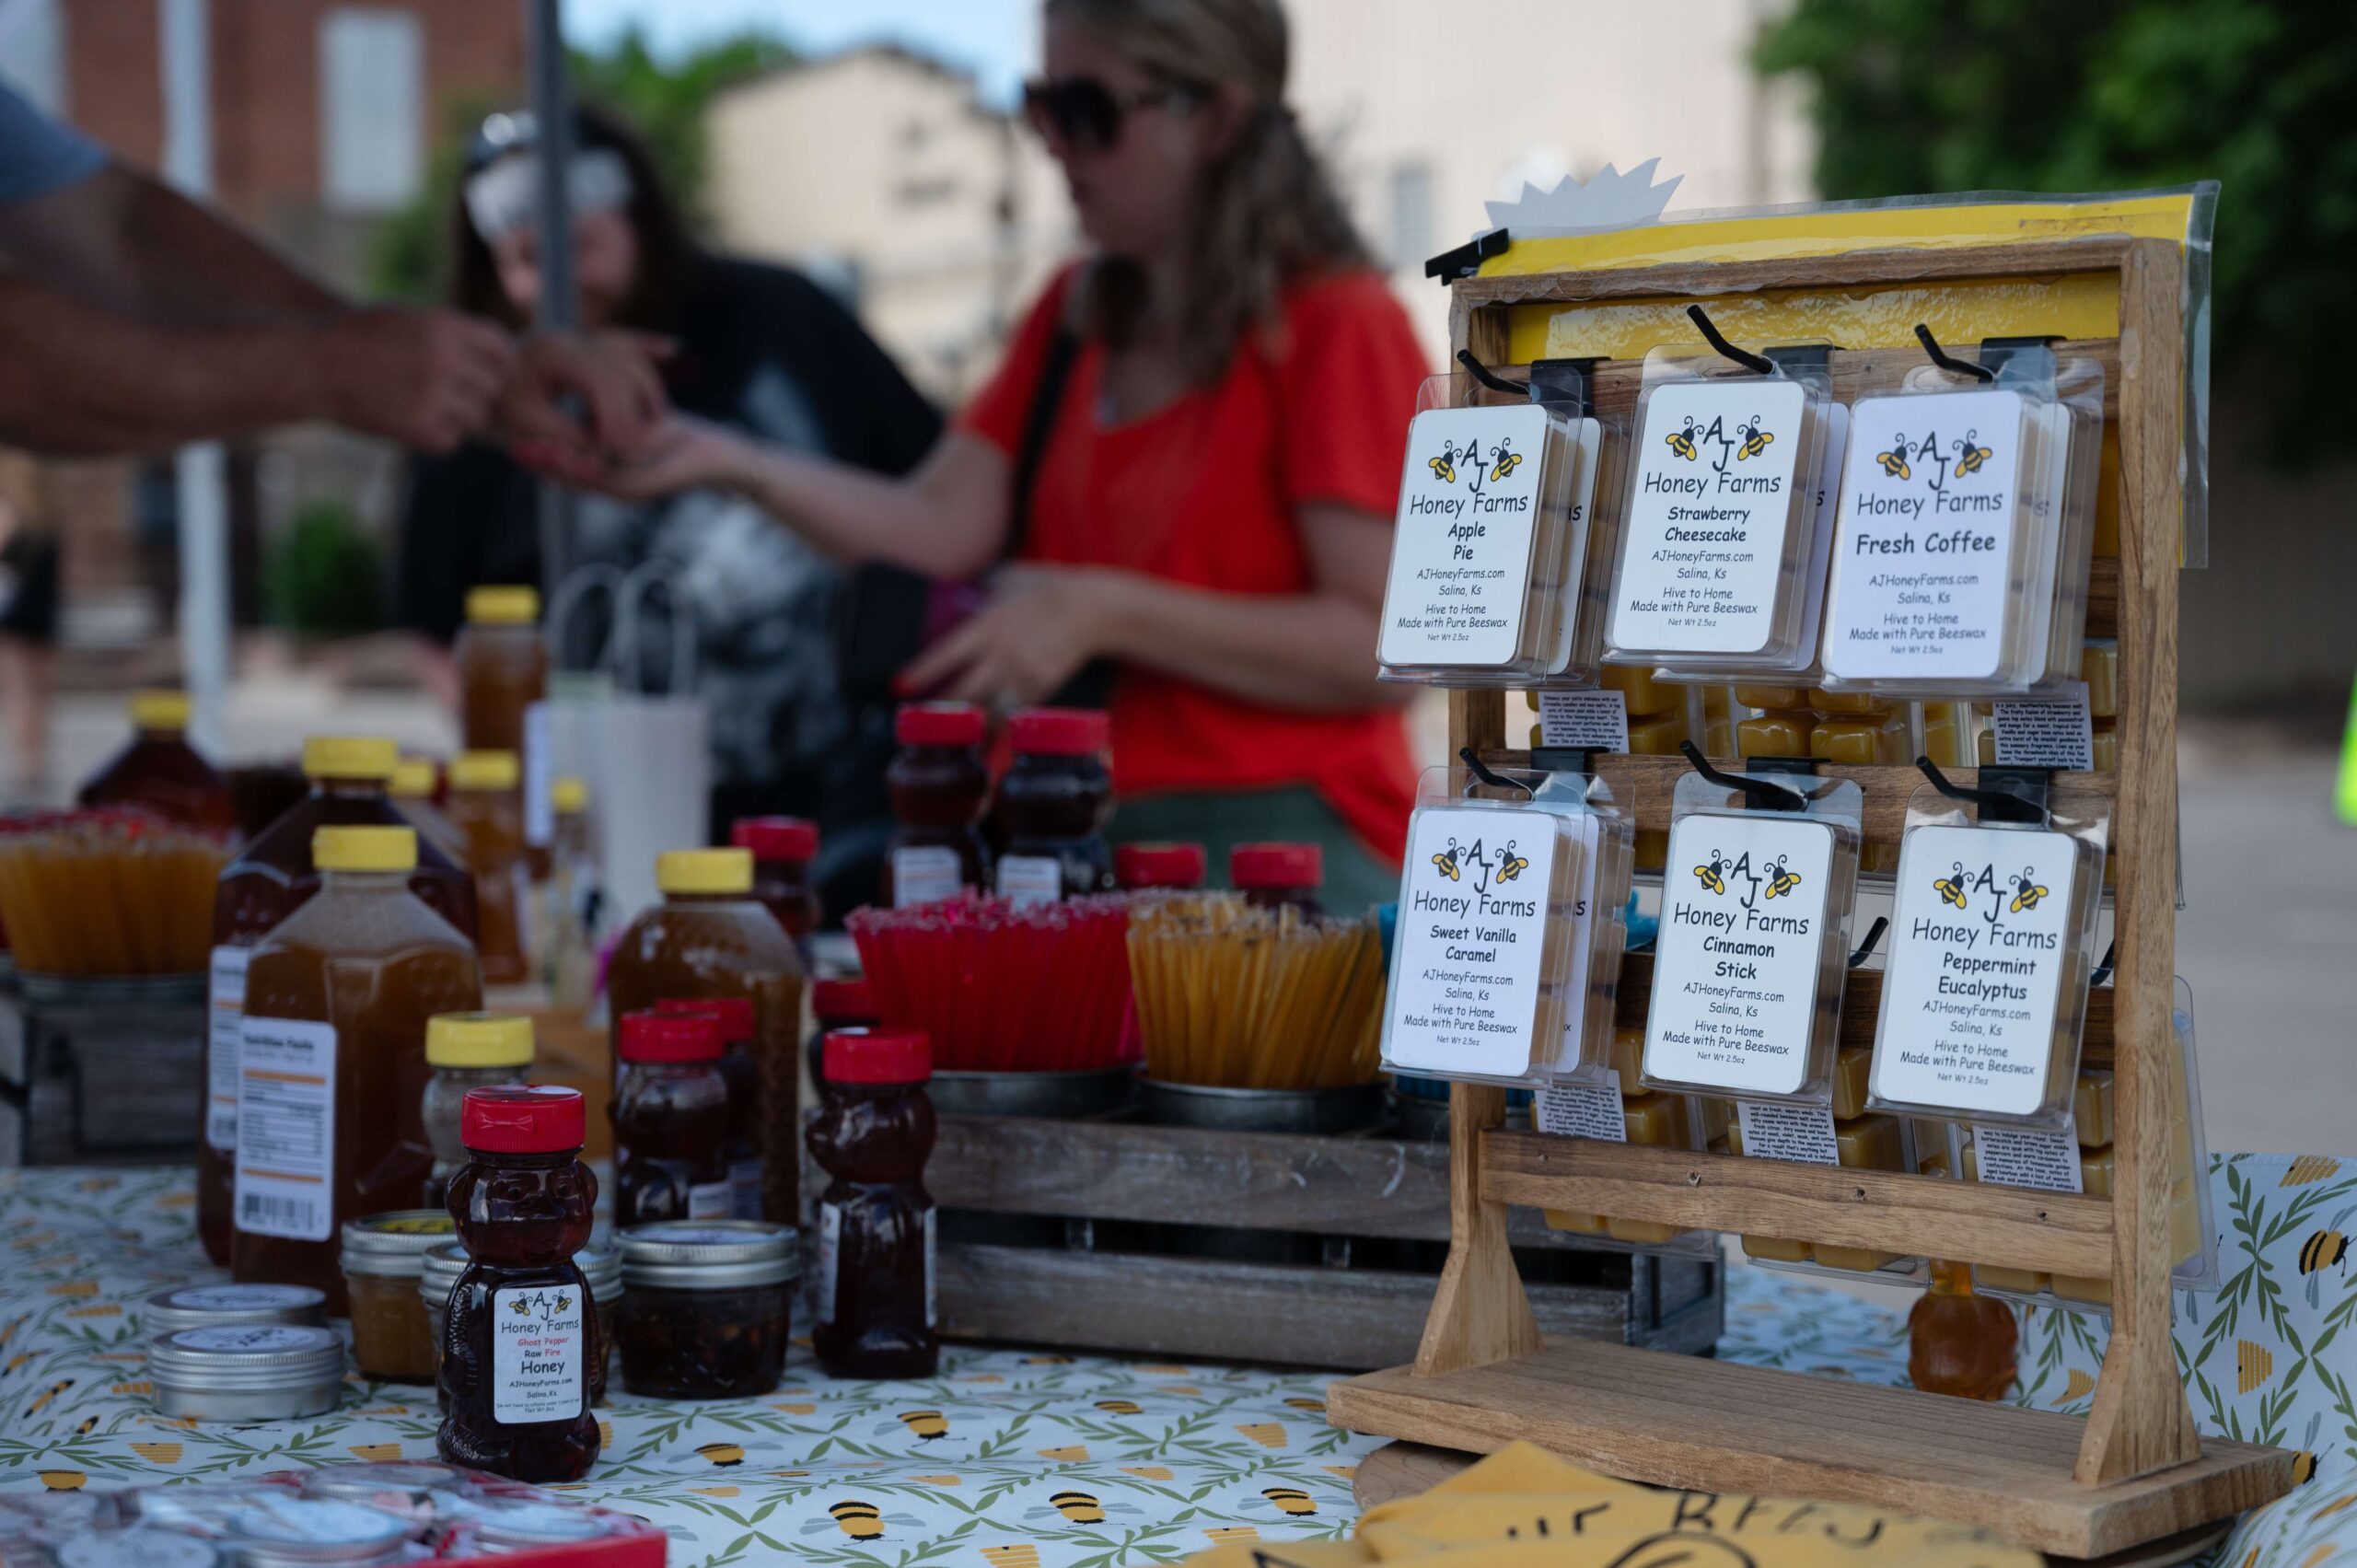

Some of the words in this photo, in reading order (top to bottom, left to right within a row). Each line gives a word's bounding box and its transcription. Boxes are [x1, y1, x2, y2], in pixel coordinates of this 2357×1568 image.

[1645, 471, 1708, 500] Honey
[1718, 471, 1781, 494] Farms
[1411, 494, 1465, 519] Honey
[1473, 493, 1528, 513] Farms
[1857, 493, 1925, 520] Honey
[1935, 491, 2003, 513] Farms
[1668, 506, 1750, 524] Strawberry
[1448, 521, 1486, 541] Apple
[1666, 528, 1746, 541] Cheesecake
[1857, 532, 1914, 555] Fresh
[1925, 530, 1995, 553] Coffee
[1454, 545, 1473, 560] Pie
[1652, 551, 1753, 564] AJHoneyFarms.com
[1417, 568, 1504, 582] AJHoneyFarms.com
[1677, 568, 1710, 580] Salina,
[1714, 568, 1726, 579] Ks
[1869, 575, 1978, 588] AJHoneyFarms.com
[1438, 585, 1468, 596] Salina,
[1471, 584, 1481, 595] Ks
[1663, 587, 1686, 598] Hive
[1690, 588, 1701, 598] to
[1704, 588, 1733, 598] Home
[1631, 600, 1658, 611] Made
[1661, 601, 1684, 612] with
[1687, 601, 1710, 612] Pure
[1713, 602, 1759, 613] Beeswax
[1898, 593, 1933, 605] Salina,
[1938, 593, 1950, 603] Ks
[1426, 604, 1446, 614] Hive
[1449, 605, 1458, 614] to
[1461, 604, 1486, 614] Home
[1398, 618, 1421, 628] Made
[1424, 619, 1444, 628] with
[1446, 619, 1466, 628] Pure
[1469, 618, 1507, 627] Beeswax
[1884, 613, 1908, 625] Hive
[1913, 615, 1924, 624] to
[1928, 613, 1958, 624] Home
[1850, 628, 1878, 640] Made
[1883, 629, 1907, 640] with
[1910, 628, 1934, 639] Pure
[1939, 627, 1986, 639] Beeswax
[1922, 645, 1943, 654] 2.5oz
[1414, 890, 1470, 919] Honey
[1479, 894, 1535, 917] Farms
[1674, 902, 1736, 934] Honey
[1747, 909, 1809, 935] Farms
[1431, 925, 1469, 940] Sweet
[1476, 927, 1516, 943] Vanilla
[1912, 917, 1980, 950] Honey
[1990, 923, 2057, 949] Farms
[1446, 947, 1496, 962] Caramel
[1703, 936, 1775, 958] Cinnamon
[1715, 961, 1757, 980] Stick
[1944, 952, 2037, 975] Peppermint
[1422, 970, 1513, 986] AJHoneyFarms.com
[1446, 988, 1474, 1001] Salina,
[1479, 989, 1489, 1001] Ks
[1684, 982, 1784, 1003] AJHoneyFarms.com
[1938, 976, 2027, 1002] Eucalyptus
[1433, 1004, 1453, 1016] Hive
[1457, 1006, 1466, 1016] to
[1469, 1006, 1494, 1018] Home
[1709, 1003, 1742, 1017] Salina,
[1747, 1005, 1758, 1016] Ks
[1922, 1001, 2030, 1020] AJHoneyFarms.com
[1404, 1015, 1429, 1027] Made
[1432, 1017, 1451, 1029] with
[1455, 1019, 1474, 1030] Pure
[1478, 1020, 1517, 1034] Beeswax
[1695, 1020, 1717, 1033] Hive
[1721, 1024, 1732, 1034] to
[1736, 1025, 1764, 1038] Home
[1949, 1021, 1984, 1036] Salina,
[1990, 1024, 2002, 1036] Ks
[1463, 1038, 1480, 1046] 2.5oz
[1663, 1031, 1690, 1044] Made
[1693, 1034, 1715, 1048] with
[1719, 1037, 1741, 1051] Pure
[1745, 1040, 1789, 1055] Beeswax
[1934, 1040, 1958, 1053] Hive
[1963, 1043, 1973, 1054] to
[1978, 1044, 2008, 1057] Home
[1697, 1051, 1711, 1061] Net
[1713, 1053, 1724, 1062] Wt
[1726, 1054, 1745, 1064] 2.5oz
[1900, 1051, 1930, 1064] Made
[1933, 1054, 1956, 1067] with
[1959, 1057, 1984, 1070] Pure
[1988, 1060, 2036, 1074] Beeswax
[1937, 1073, 1952, 1081] Net
[1955, 1074, 1966, 1083] Wt
[1968, 1075, 1988, 1085] 2.5oz
[502, 1322, 540, 1336] Honey
[547, 1319, 579, 1331] Farms
[517, 1339, 541, 1347] Ghost
[544, 1337, 569, 1346] Pepper
[525, 1350, 541, 1358] Raw
[521, 1361, 565, 1376] Honey
[509, 1378, 573, 1388] AJHoneyFarms.com
